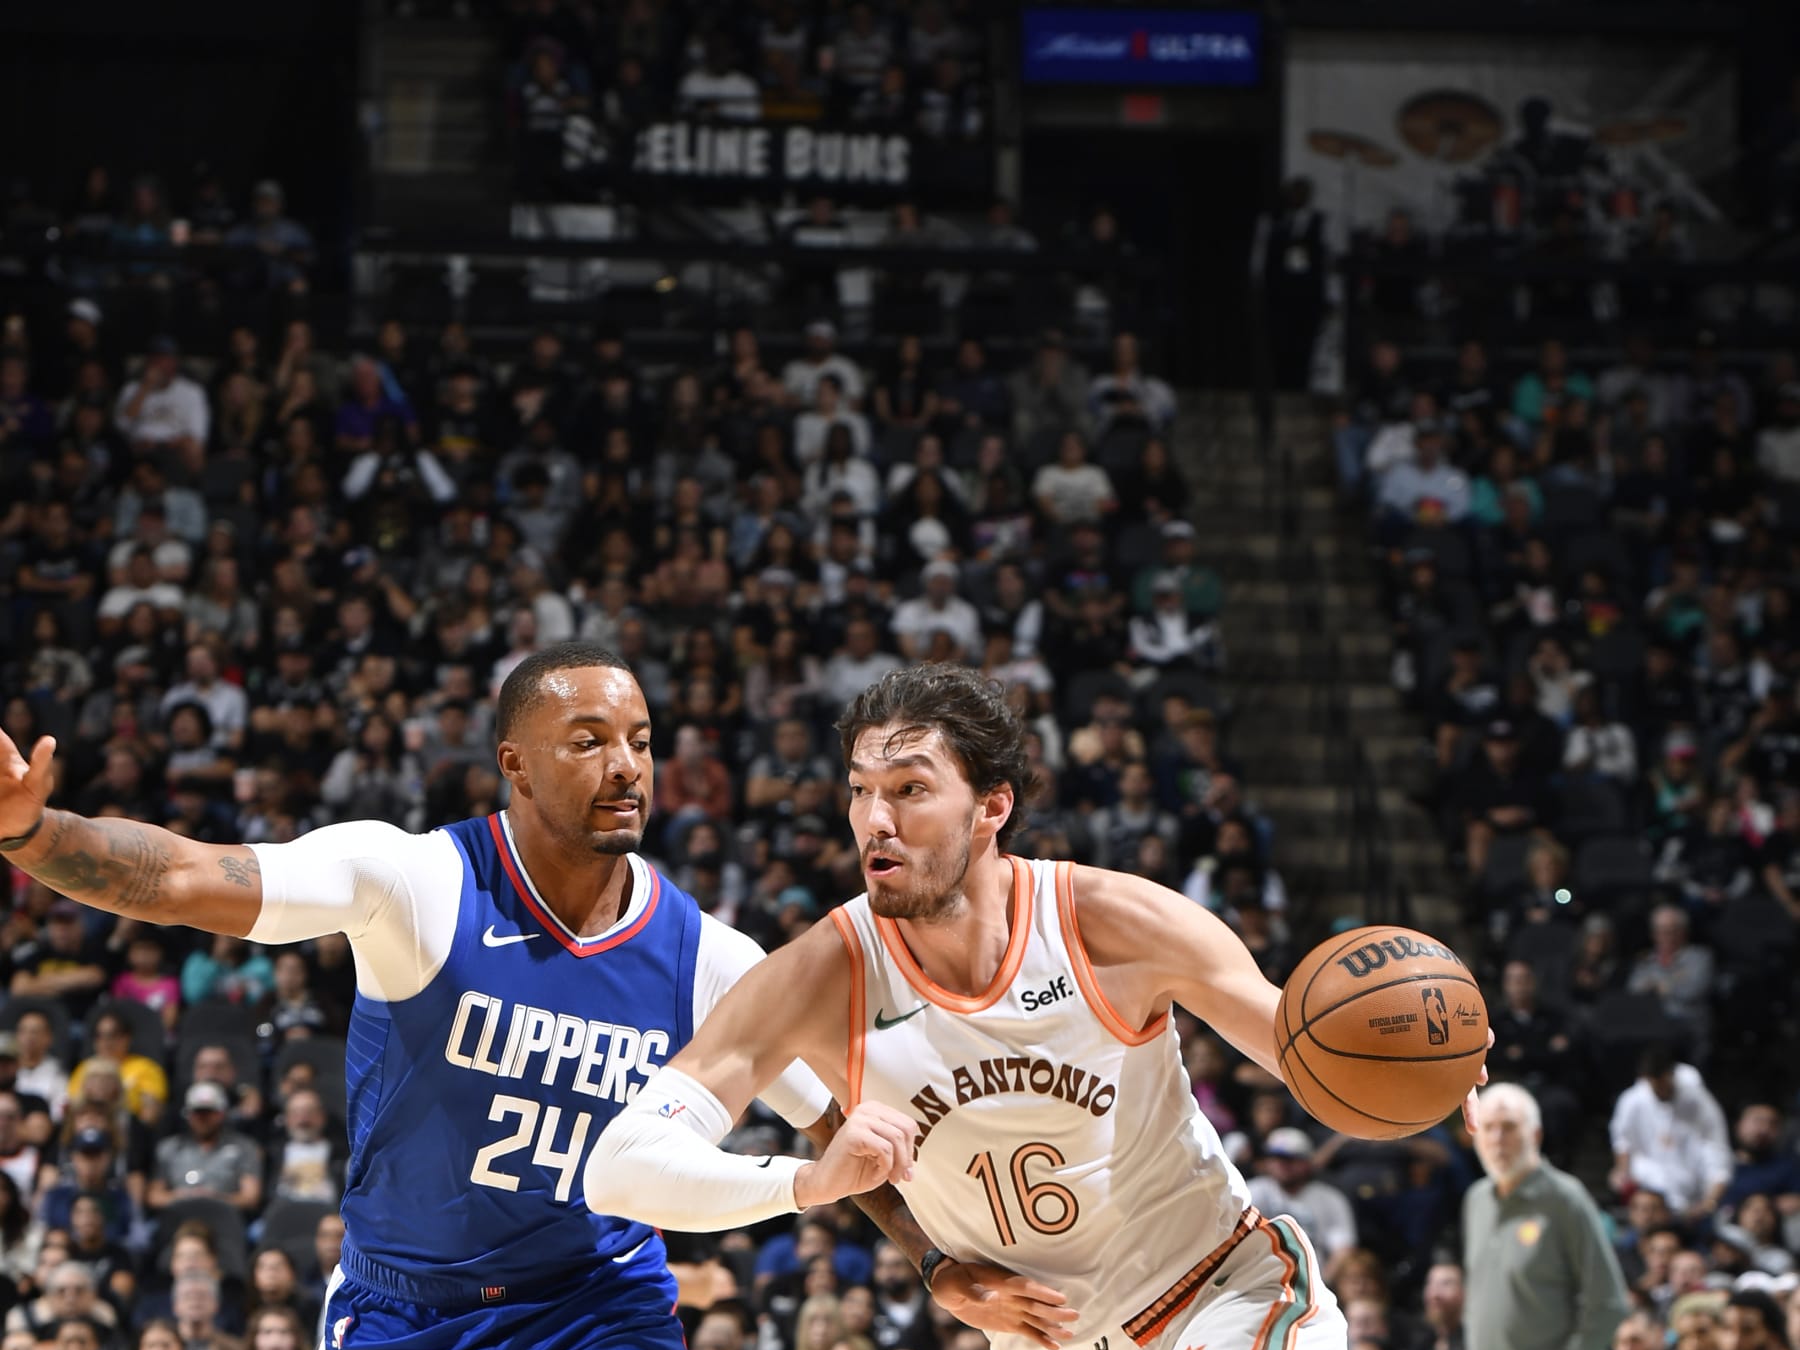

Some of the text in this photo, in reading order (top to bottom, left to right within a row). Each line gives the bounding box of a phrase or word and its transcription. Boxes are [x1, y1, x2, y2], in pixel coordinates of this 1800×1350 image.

[562, 114, 912, 186] ELINE BUMS
[1020, 974, 1075, 1013] Self.
[1338, 937, 1463, 977] Wilson
[445, 990, 670, 1105] CLIPPERS
[1406, 1013, 1419, 1023] BALL
[470, 1094, 593, 1203] 24
[909, 1056, 1118, 1162] AN ANTONIO
[966, 1142, 1080, 1247] 16
